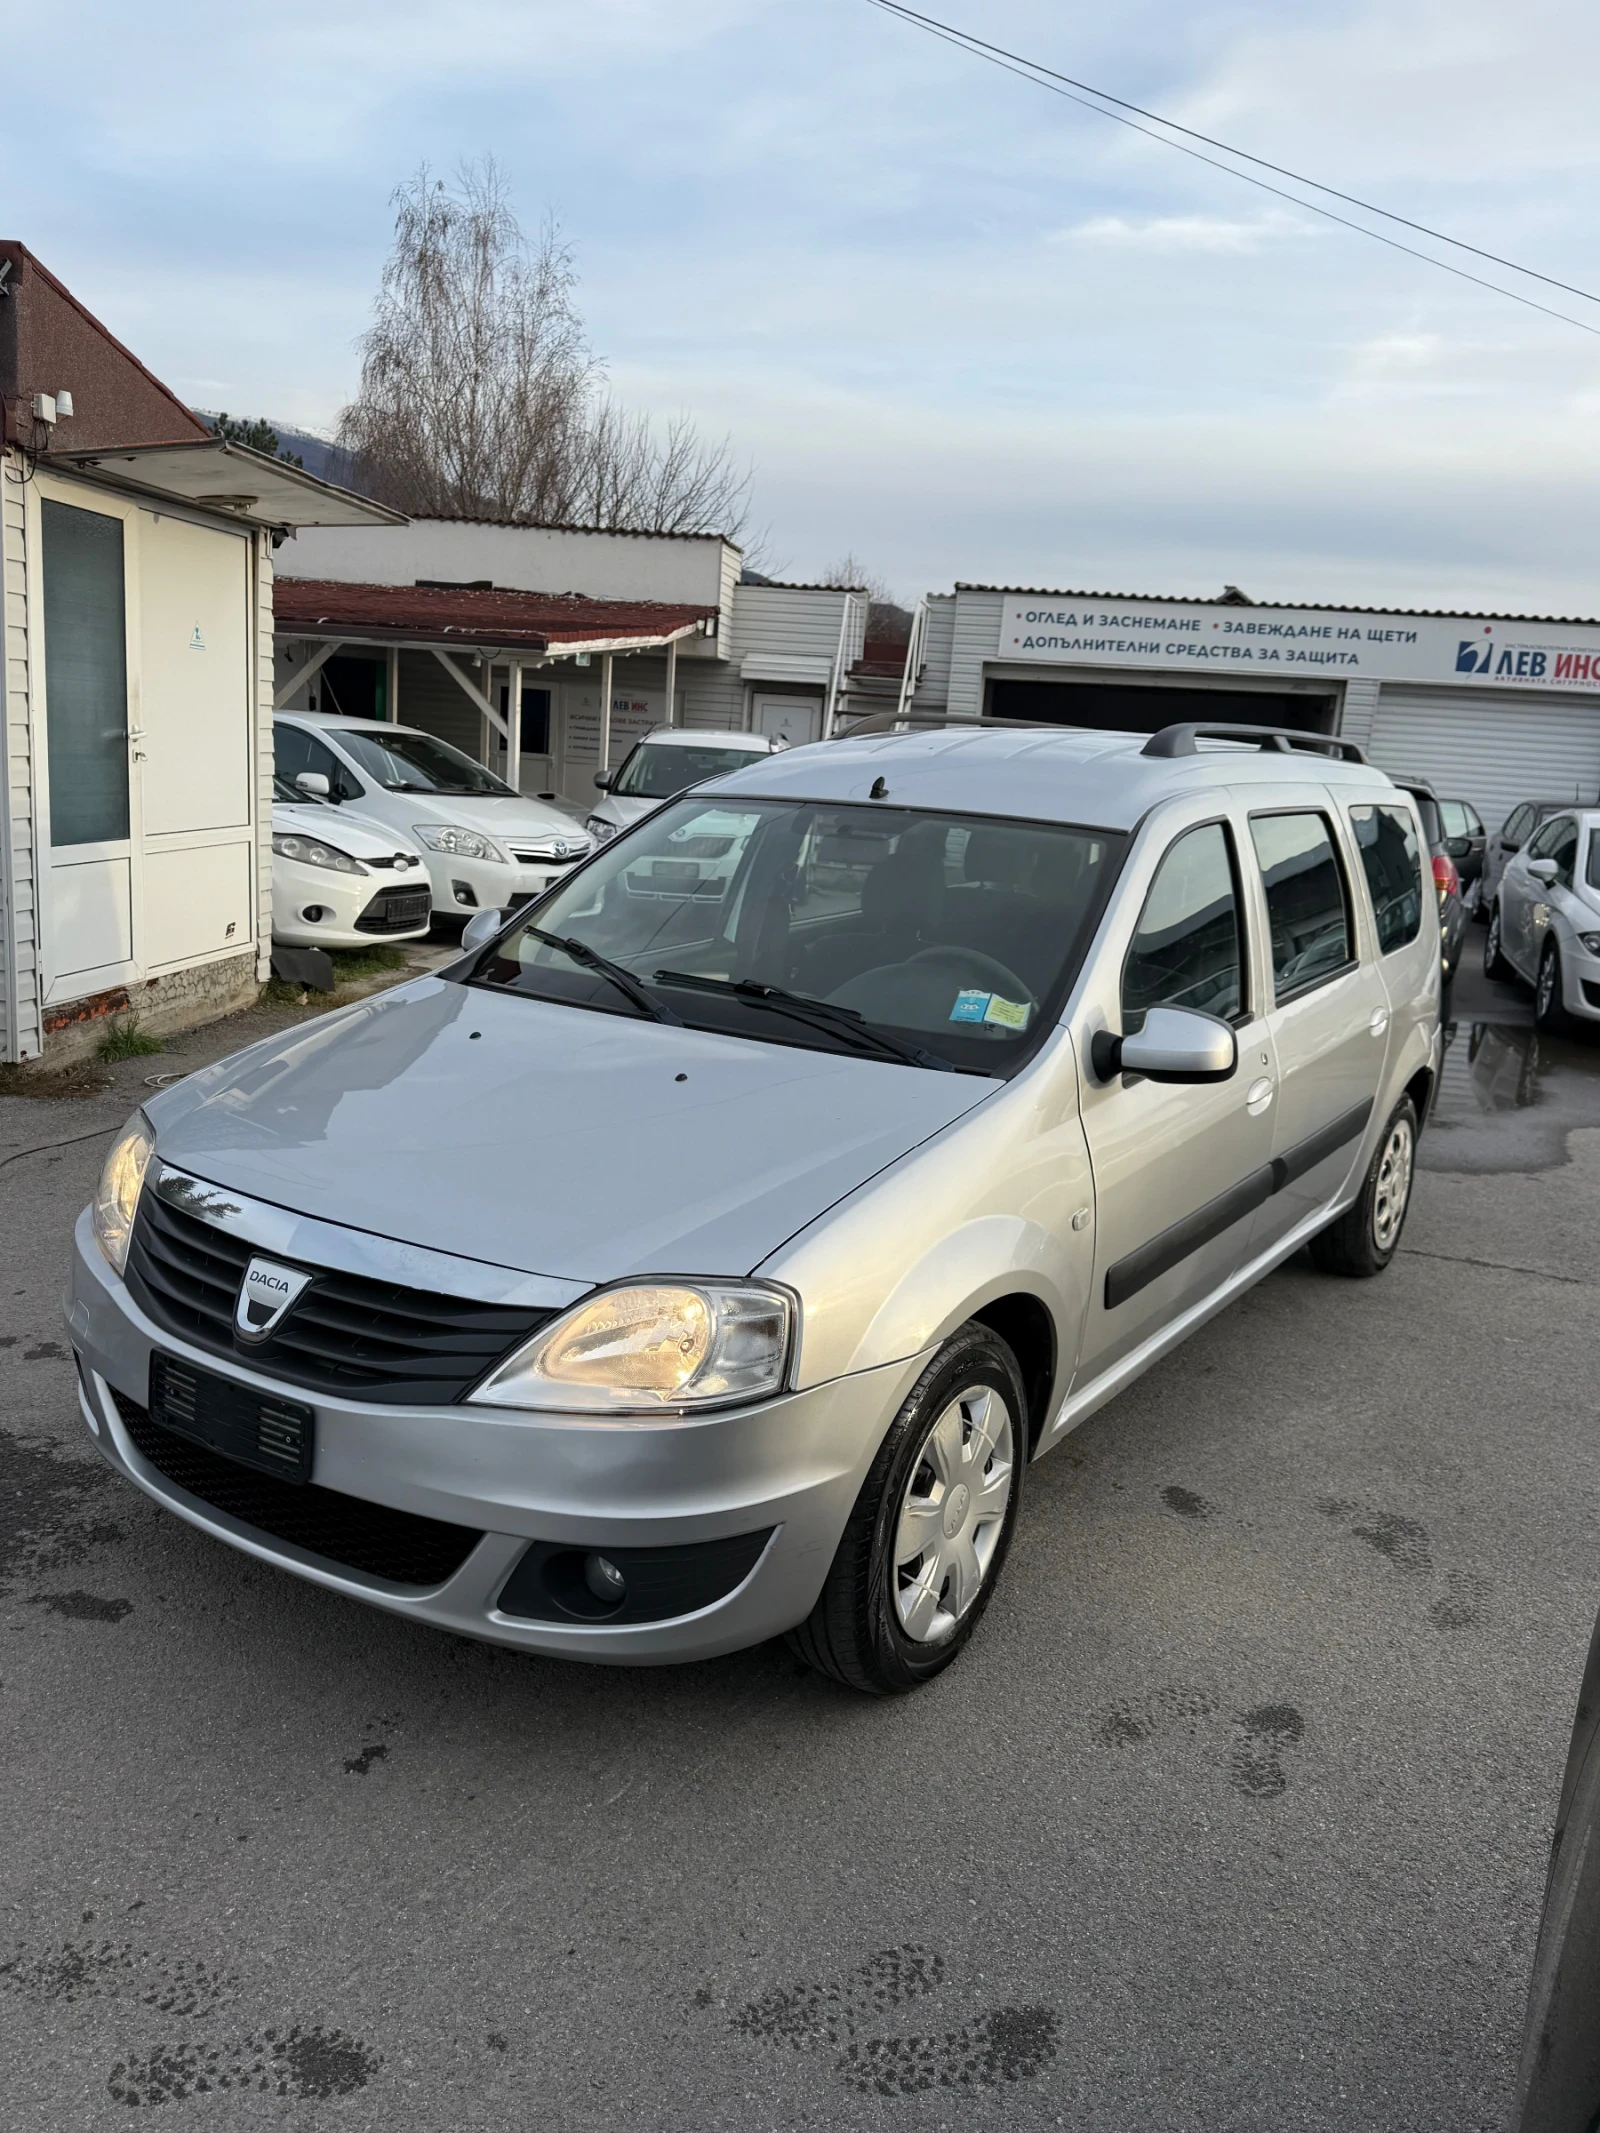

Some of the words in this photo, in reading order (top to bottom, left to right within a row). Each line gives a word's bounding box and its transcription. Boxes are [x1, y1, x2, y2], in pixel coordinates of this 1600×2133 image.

[1026, 611, 1077, 627] ОГЛЕД
[1083, 614, 1094, 626] И
[1099, 615, 1202, 631] ЗАСНЕМАНЕ
[1223, 621, 1332, 639] ЗАВЕЖДАНЕ
[1337, 628, 1361, 640] НА
[1367, 630, 1418, 643] ЩЕТИ
[1022, 636, 1160, 654] ДОПЪЛНИТЕЛНИ
[1165, 643, 1253, 660] СРЕДСТВА
[1258, 648, 1279, 660] ЗА
[1285, 649, 1359, 665] ЗАЩИТА
[1495, 650, 1547, 677] ЛЕВ
[613, 700, 629, 711] ЛЕВ
[631, 701, 648, 712] ИНС
[249, 1270, 290, 1294] DACIA
